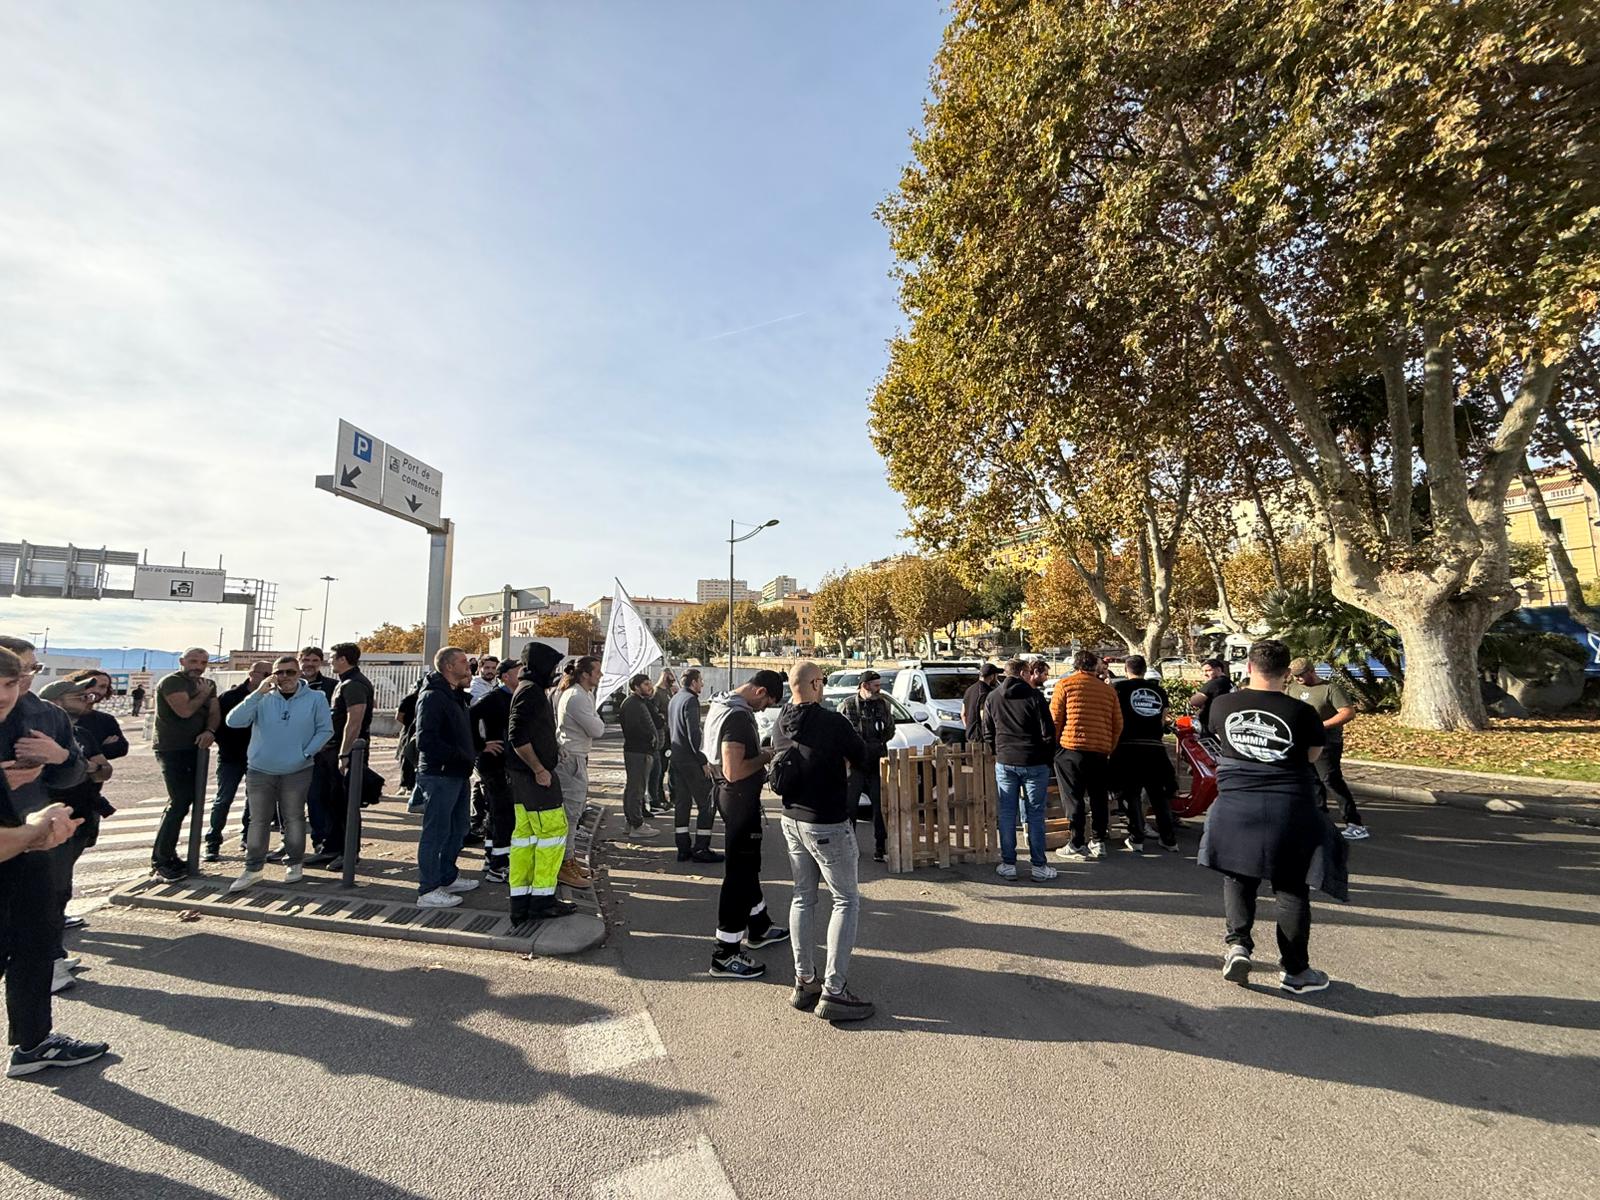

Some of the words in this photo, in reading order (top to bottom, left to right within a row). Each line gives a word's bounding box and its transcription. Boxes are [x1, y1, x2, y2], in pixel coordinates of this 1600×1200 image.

[357, 435, 369, 456] P
[402, 457, 419, 475] Port
[421, 469, 431, 480] de
[401, 474, 440, 497] commerce
[1231, 734, 1267, 747] SAMMM
